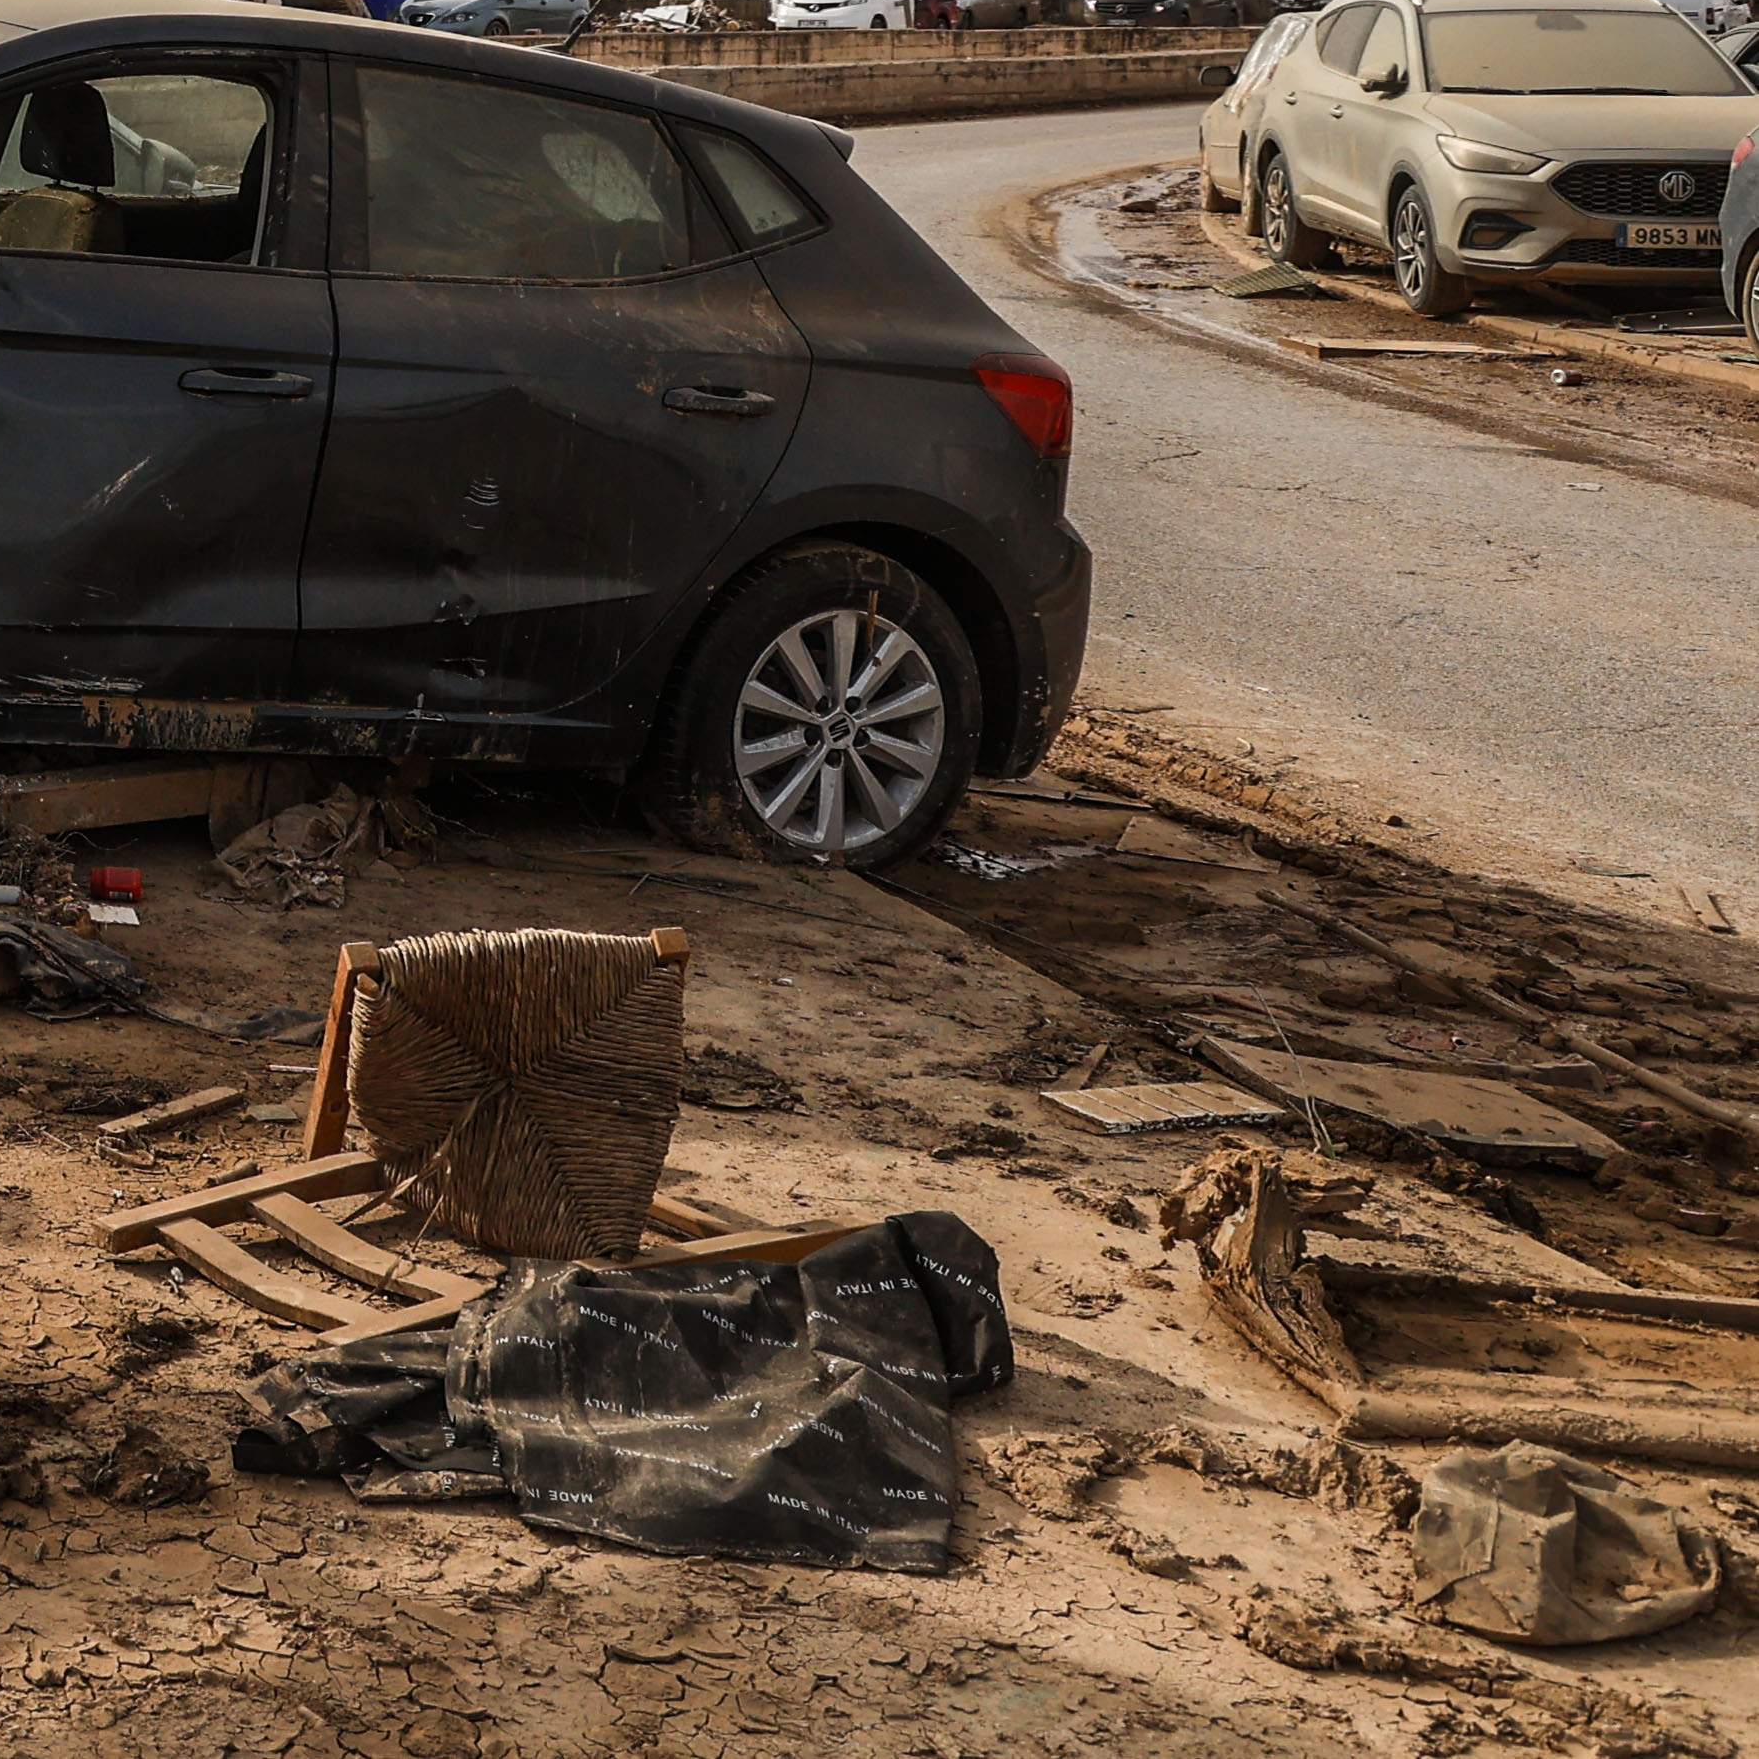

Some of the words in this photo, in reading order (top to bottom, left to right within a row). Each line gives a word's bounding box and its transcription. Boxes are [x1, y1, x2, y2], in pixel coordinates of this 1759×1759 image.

[1664, 174, 1692, 198] MG
[1635, 227, 1688, 245] 9853
[1696, 228, 1723, 246] MN
[835, 1282, 873, 1296] ITALY
[579, 1305, 618, 1327] MADE
[624, 1321, 638, 1335] IN
[643, 1329, 679, 1353] ITALY
[701, 1308, 737, 1335] MADE
[741, 1328, 754, 1342] IN
[495, 1335, 510, 1345] IN
[517, 1335, 557, 1351] ITALY
[881, 1361, 918, 1379] MADE
[923, 1368, 936, 1381] IN
[584, 1396, 624, 1415] ITALY
[809, 1417, 845, 1443] MADE
[548, 1489, 594, 1504] MADE
[881, 1485, 929, 1502] MADE
[933, 1493, 949, 1504] IN
[767, 1492, 811, 1513] MADE
[817, 1505, 831, 1520] IN
[834, 1513, 871, 1536] ITALY
